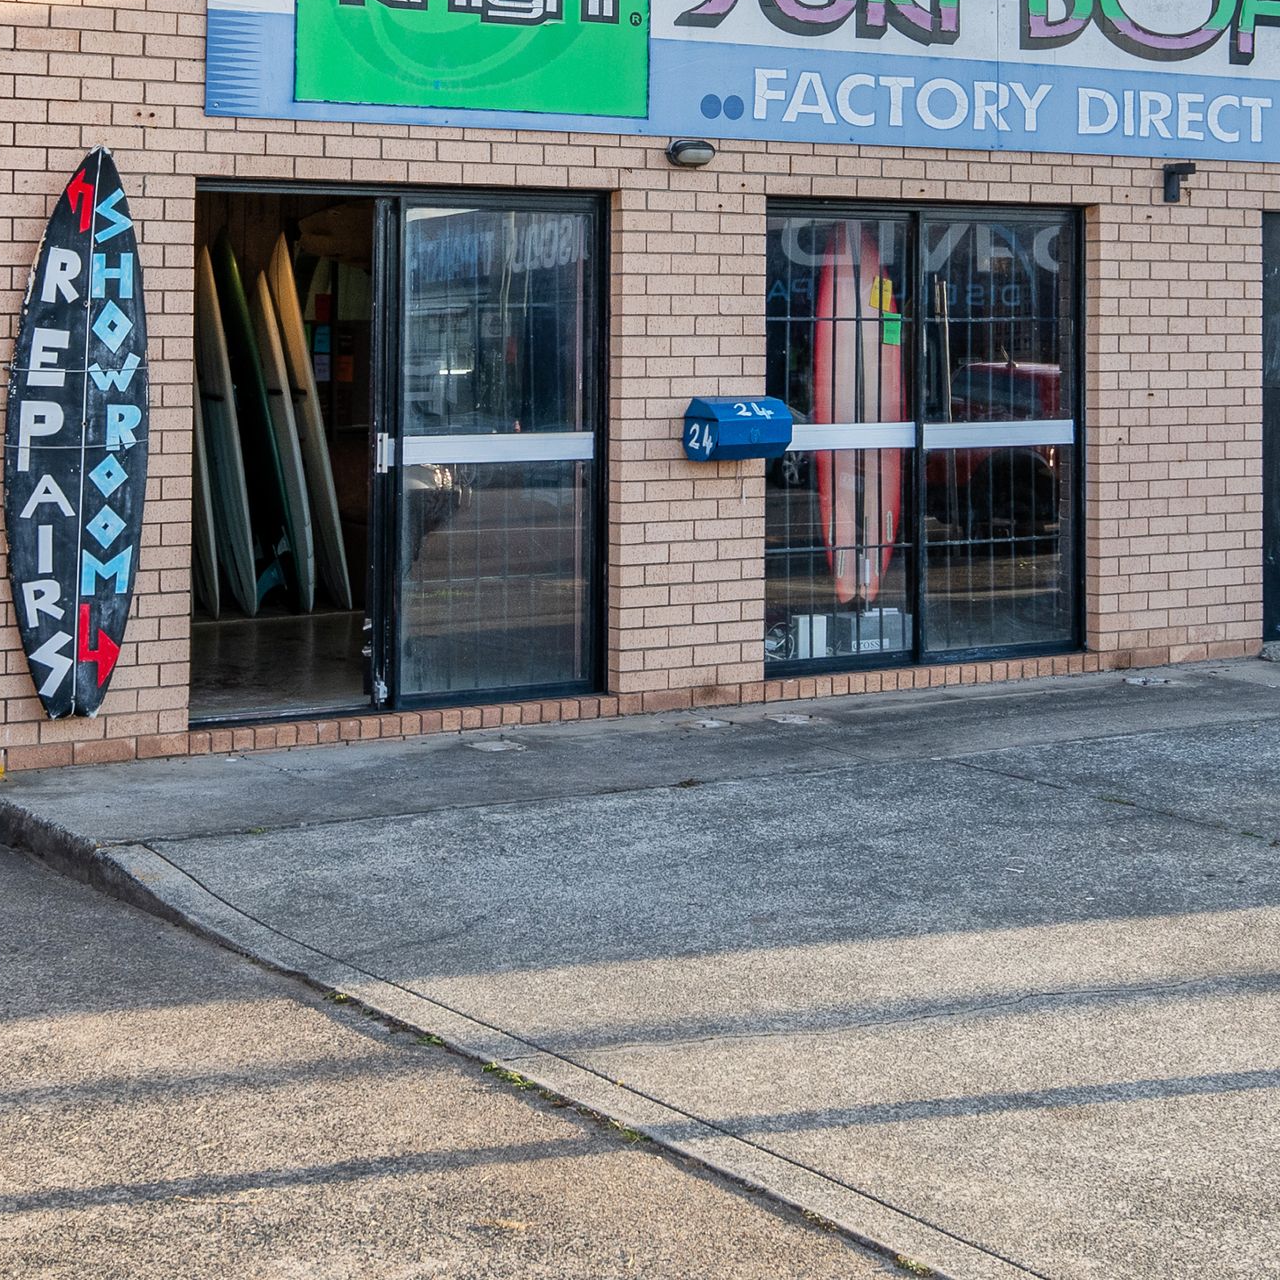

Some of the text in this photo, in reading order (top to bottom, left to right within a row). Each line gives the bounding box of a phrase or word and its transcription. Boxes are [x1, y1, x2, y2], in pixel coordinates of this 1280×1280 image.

[754, 66, 1053, 133] FACTORY
[1078, 87, 1270, 144] DIRECT
[81, 188, 142, 596] SHOWROOM
[733, 403, 774, 420] 24
[17, 247, 81, 697] REPAIRS
[688, 423, 714, 456] 24
